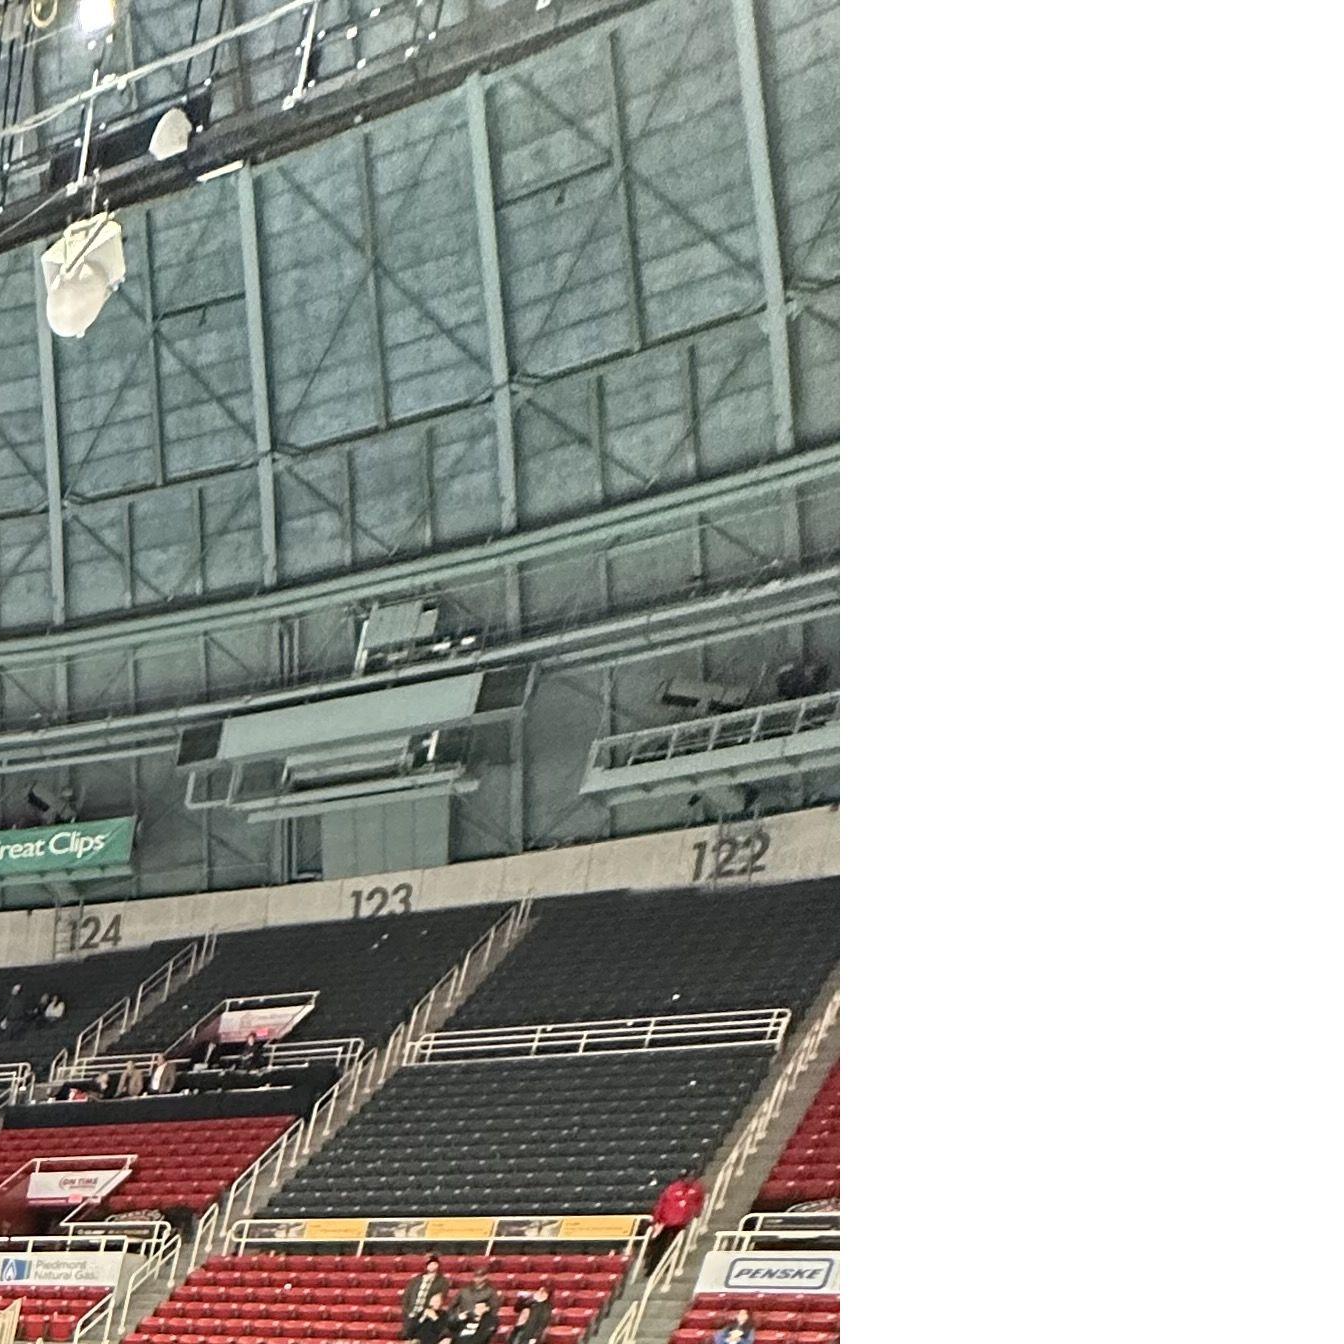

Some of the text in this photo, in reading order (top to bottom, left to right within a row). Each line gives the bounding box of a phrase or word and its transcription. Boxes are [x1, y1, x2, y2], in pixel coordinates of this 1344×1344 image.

[48, 829, 109, 859] Clips
[691, 832, 772, 881] 122
[349, 883, 414, 919] 123
[68, 914, 123, 951] 124
[33, 1269, 72, 1281] Natural
[34, 1260, 87, 1271] Piedmont
[734, 1267, 824, 1280] PENSKE
